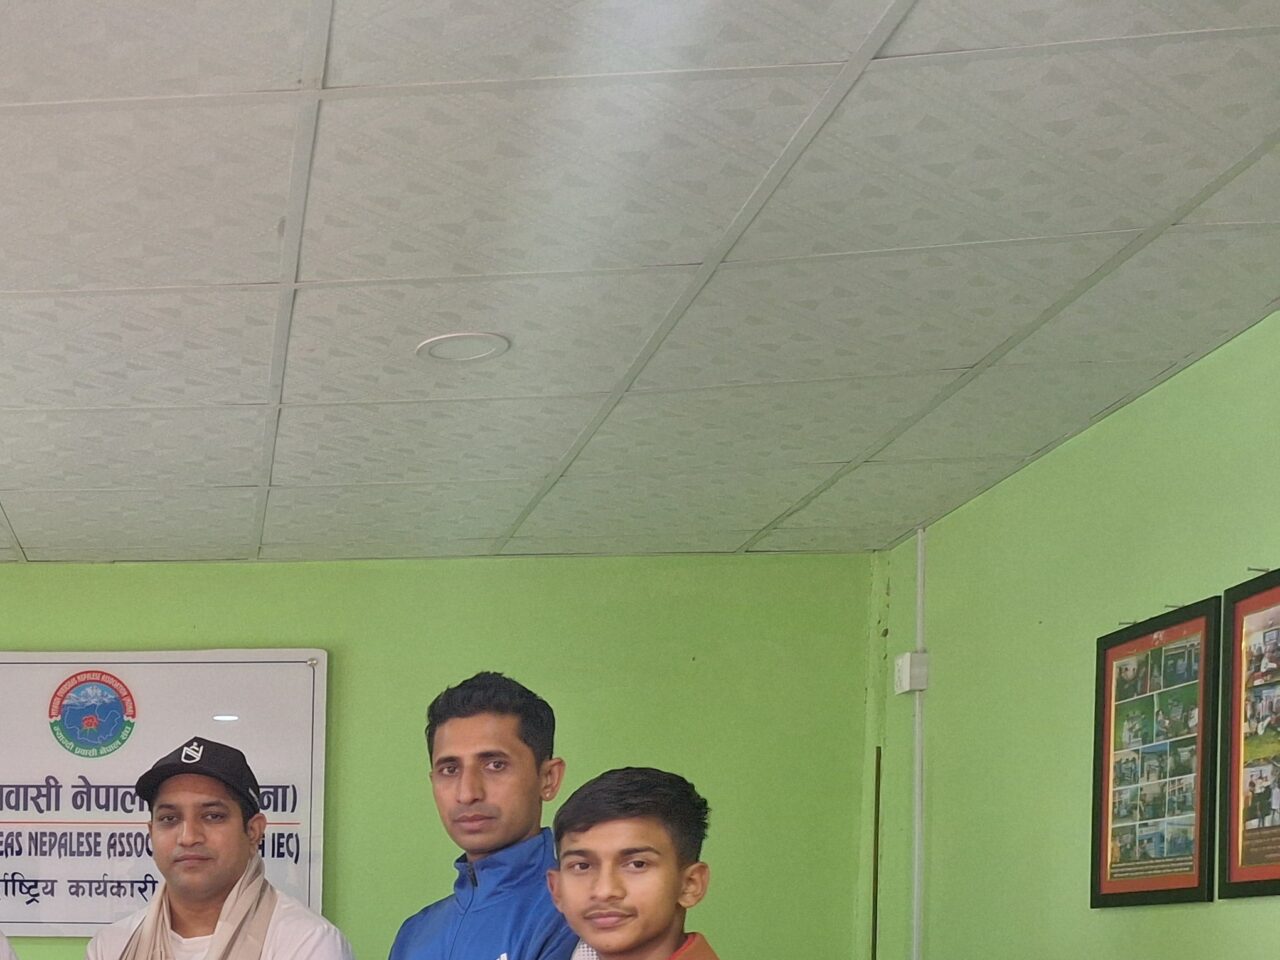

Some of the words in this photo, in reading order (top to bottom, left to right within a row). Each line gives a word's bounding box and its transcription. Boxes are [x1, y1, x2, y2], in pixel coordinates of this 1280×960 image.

[71, 775, 150, 813] नेपाल
[260, 784, 298, 813] ना)
[28, 831, 102, 859] NEPALESE
[107, 831, 152, 859] ASSOC
[272, 832, 300, 864] IEC)
[67, 873, 159, 902] कार्यकारी
